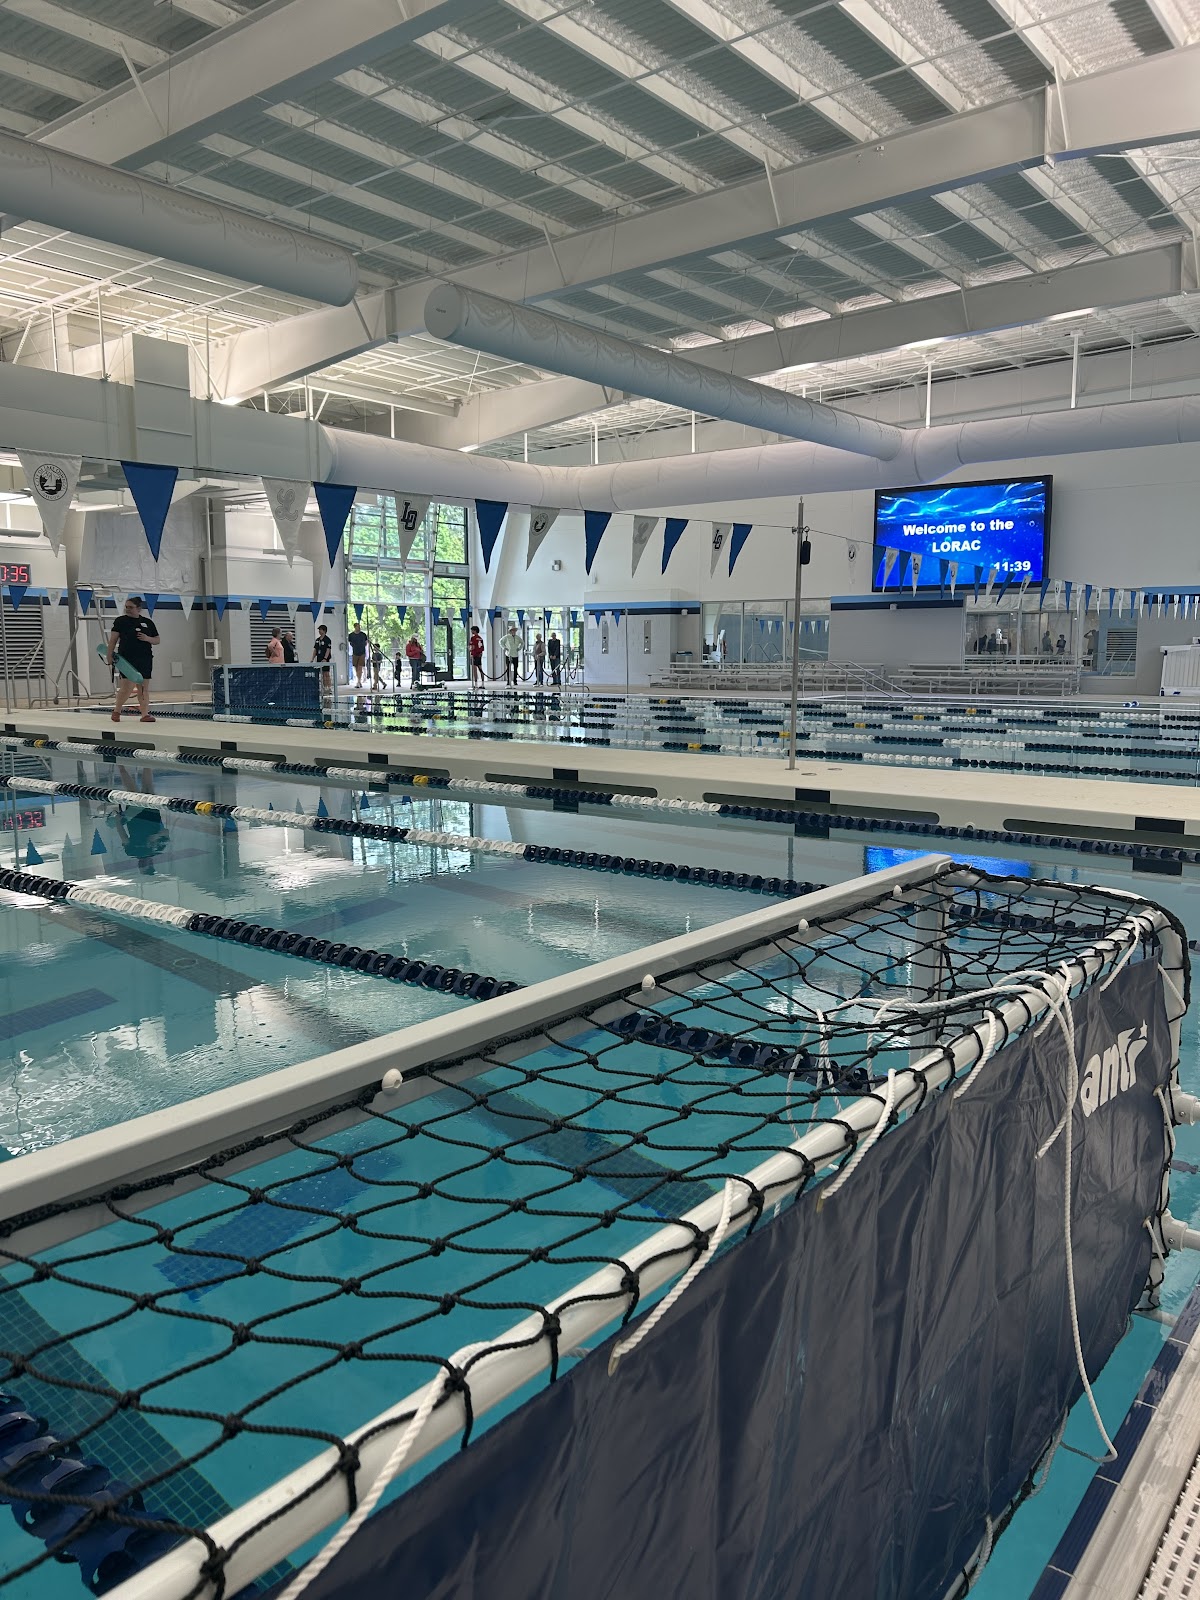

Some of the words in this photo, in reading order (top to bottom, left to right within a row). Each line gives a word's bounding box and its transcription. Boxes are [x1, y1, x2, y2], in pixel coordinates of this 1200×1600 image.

[902, 522, 967, 536] Welcome
[970, 520, 986, 532] to
[989, 518, 1015, 531] the
[931, 539, 982, 553] LORAC
[993, 560, 1032, 572] 11:39
